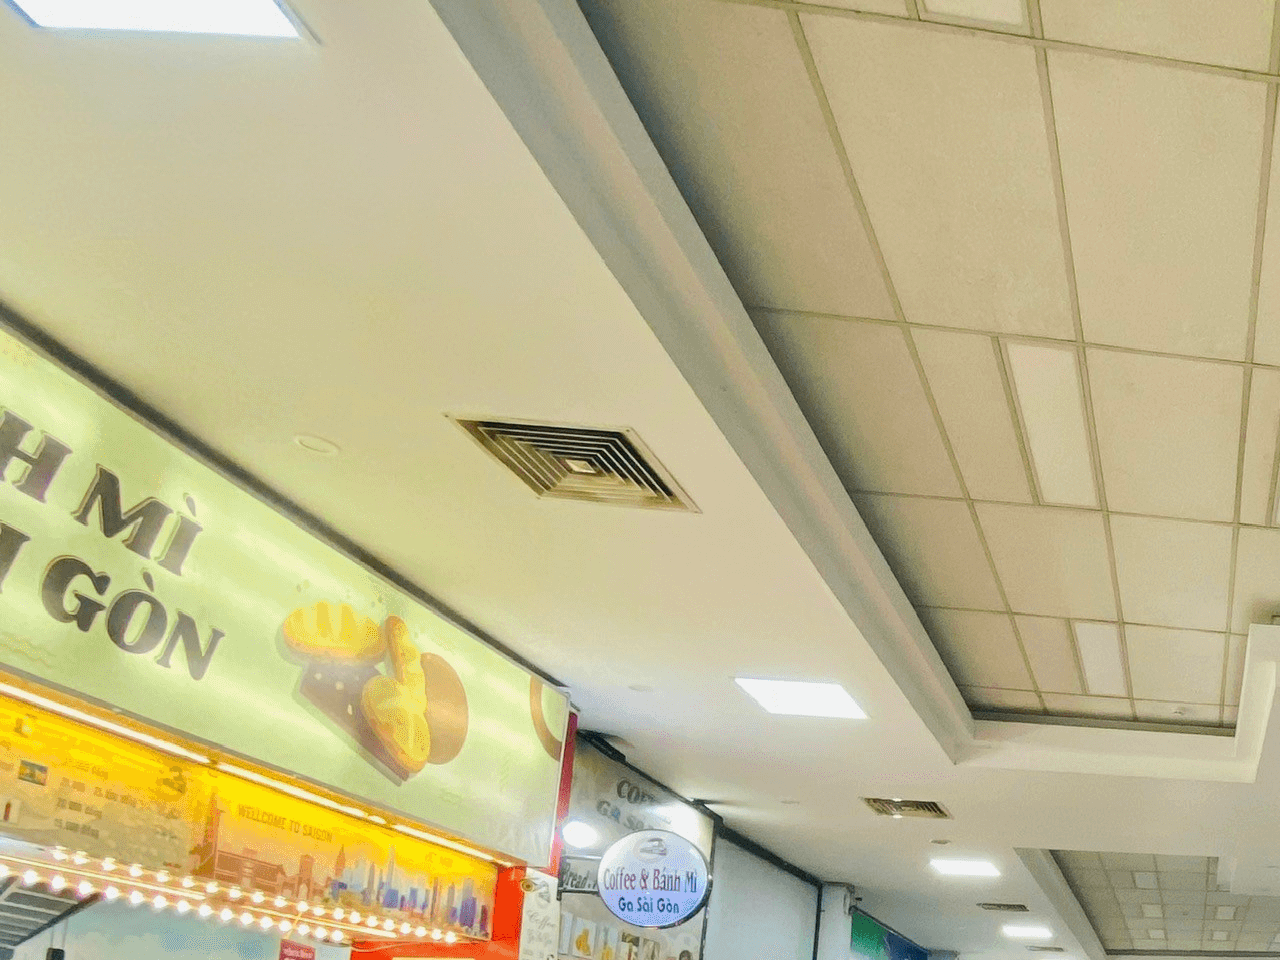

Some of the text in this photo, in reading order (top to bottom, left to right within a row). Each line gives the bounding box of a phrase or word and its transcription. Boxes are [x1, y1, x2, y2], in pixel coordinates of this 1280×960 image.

[71, 463, 203, 576] MÌ
[41, 555, 226, 681] GÒN
[290, 820, 300, 834] TO
[604, 867, 697, 893] Coffee & Bánh Mì
[618, 896, 680, 913] Ga Sài Gòn
